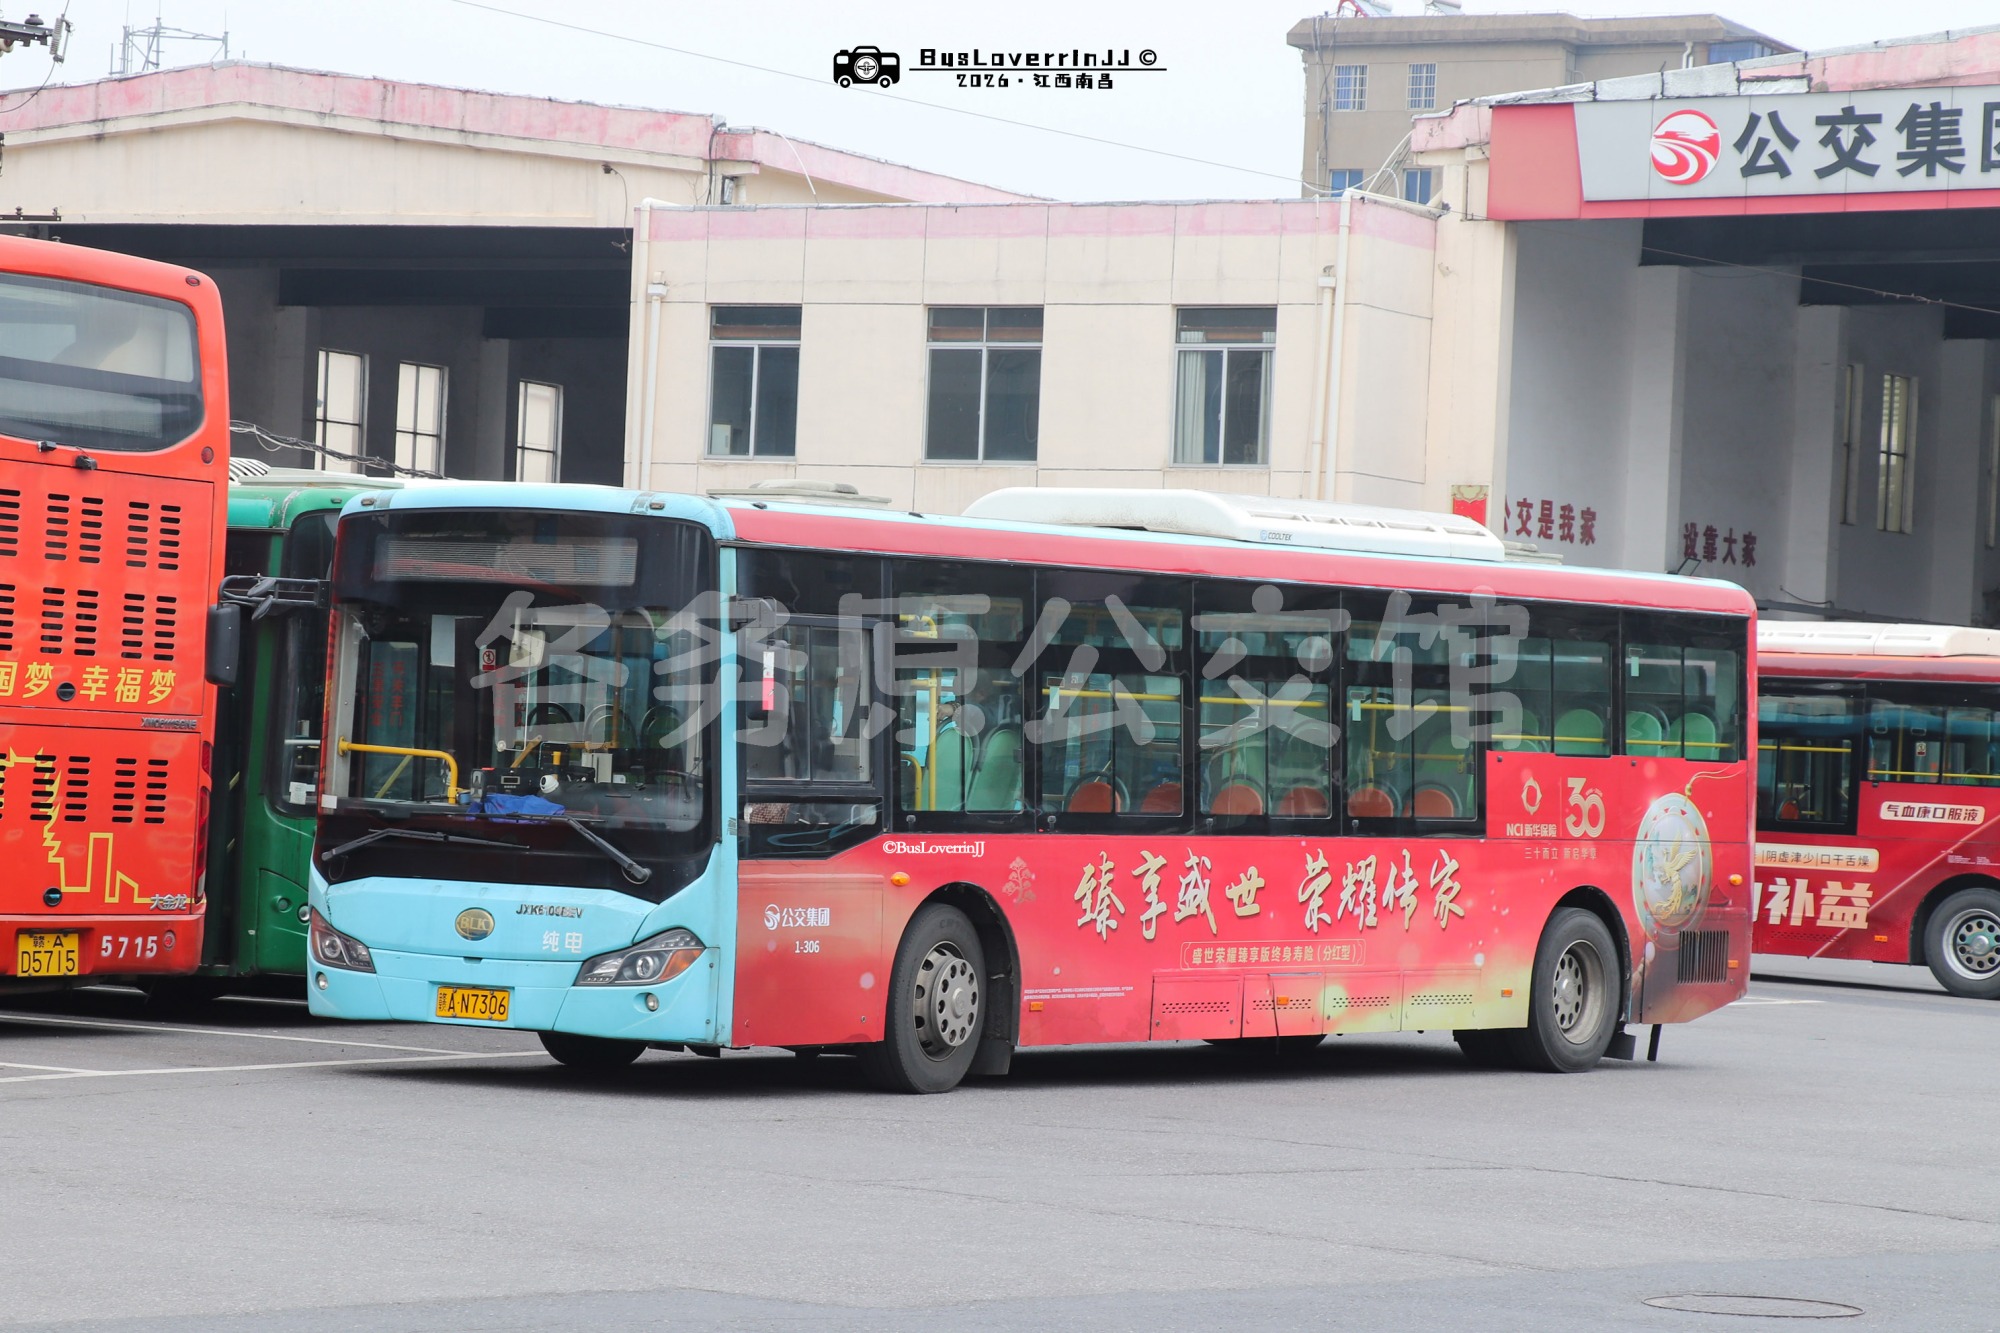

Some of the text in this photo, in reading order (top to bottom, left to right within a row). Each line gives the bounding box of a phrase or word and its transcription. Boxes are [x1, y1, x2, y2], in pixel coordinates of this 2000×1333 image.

[1733, 101, 2000, 179] 公交集
[1683, 522, 1757, 568] 设靠大家
[80, 665, 176, 705] 幸福梦
[1887, 804, 1979, 822] 气血康口服液
[1506, 823, 1557, 837] NCI 新华保险
[1524, 846, 1597, 860] 三十而立 新启华章
[150, 893, 187, 910] 大金龙
[1074, 847, 1465, 941] 臻享盛世 荣耀传家
[781, 907, 830, 928] 公交集团
[101, 935, 158, 959] 5715
[542, 930, 583, 953] 纯电
[795, 940, 820, 953] 1-306
[21, 949, 76, 974] D5715
